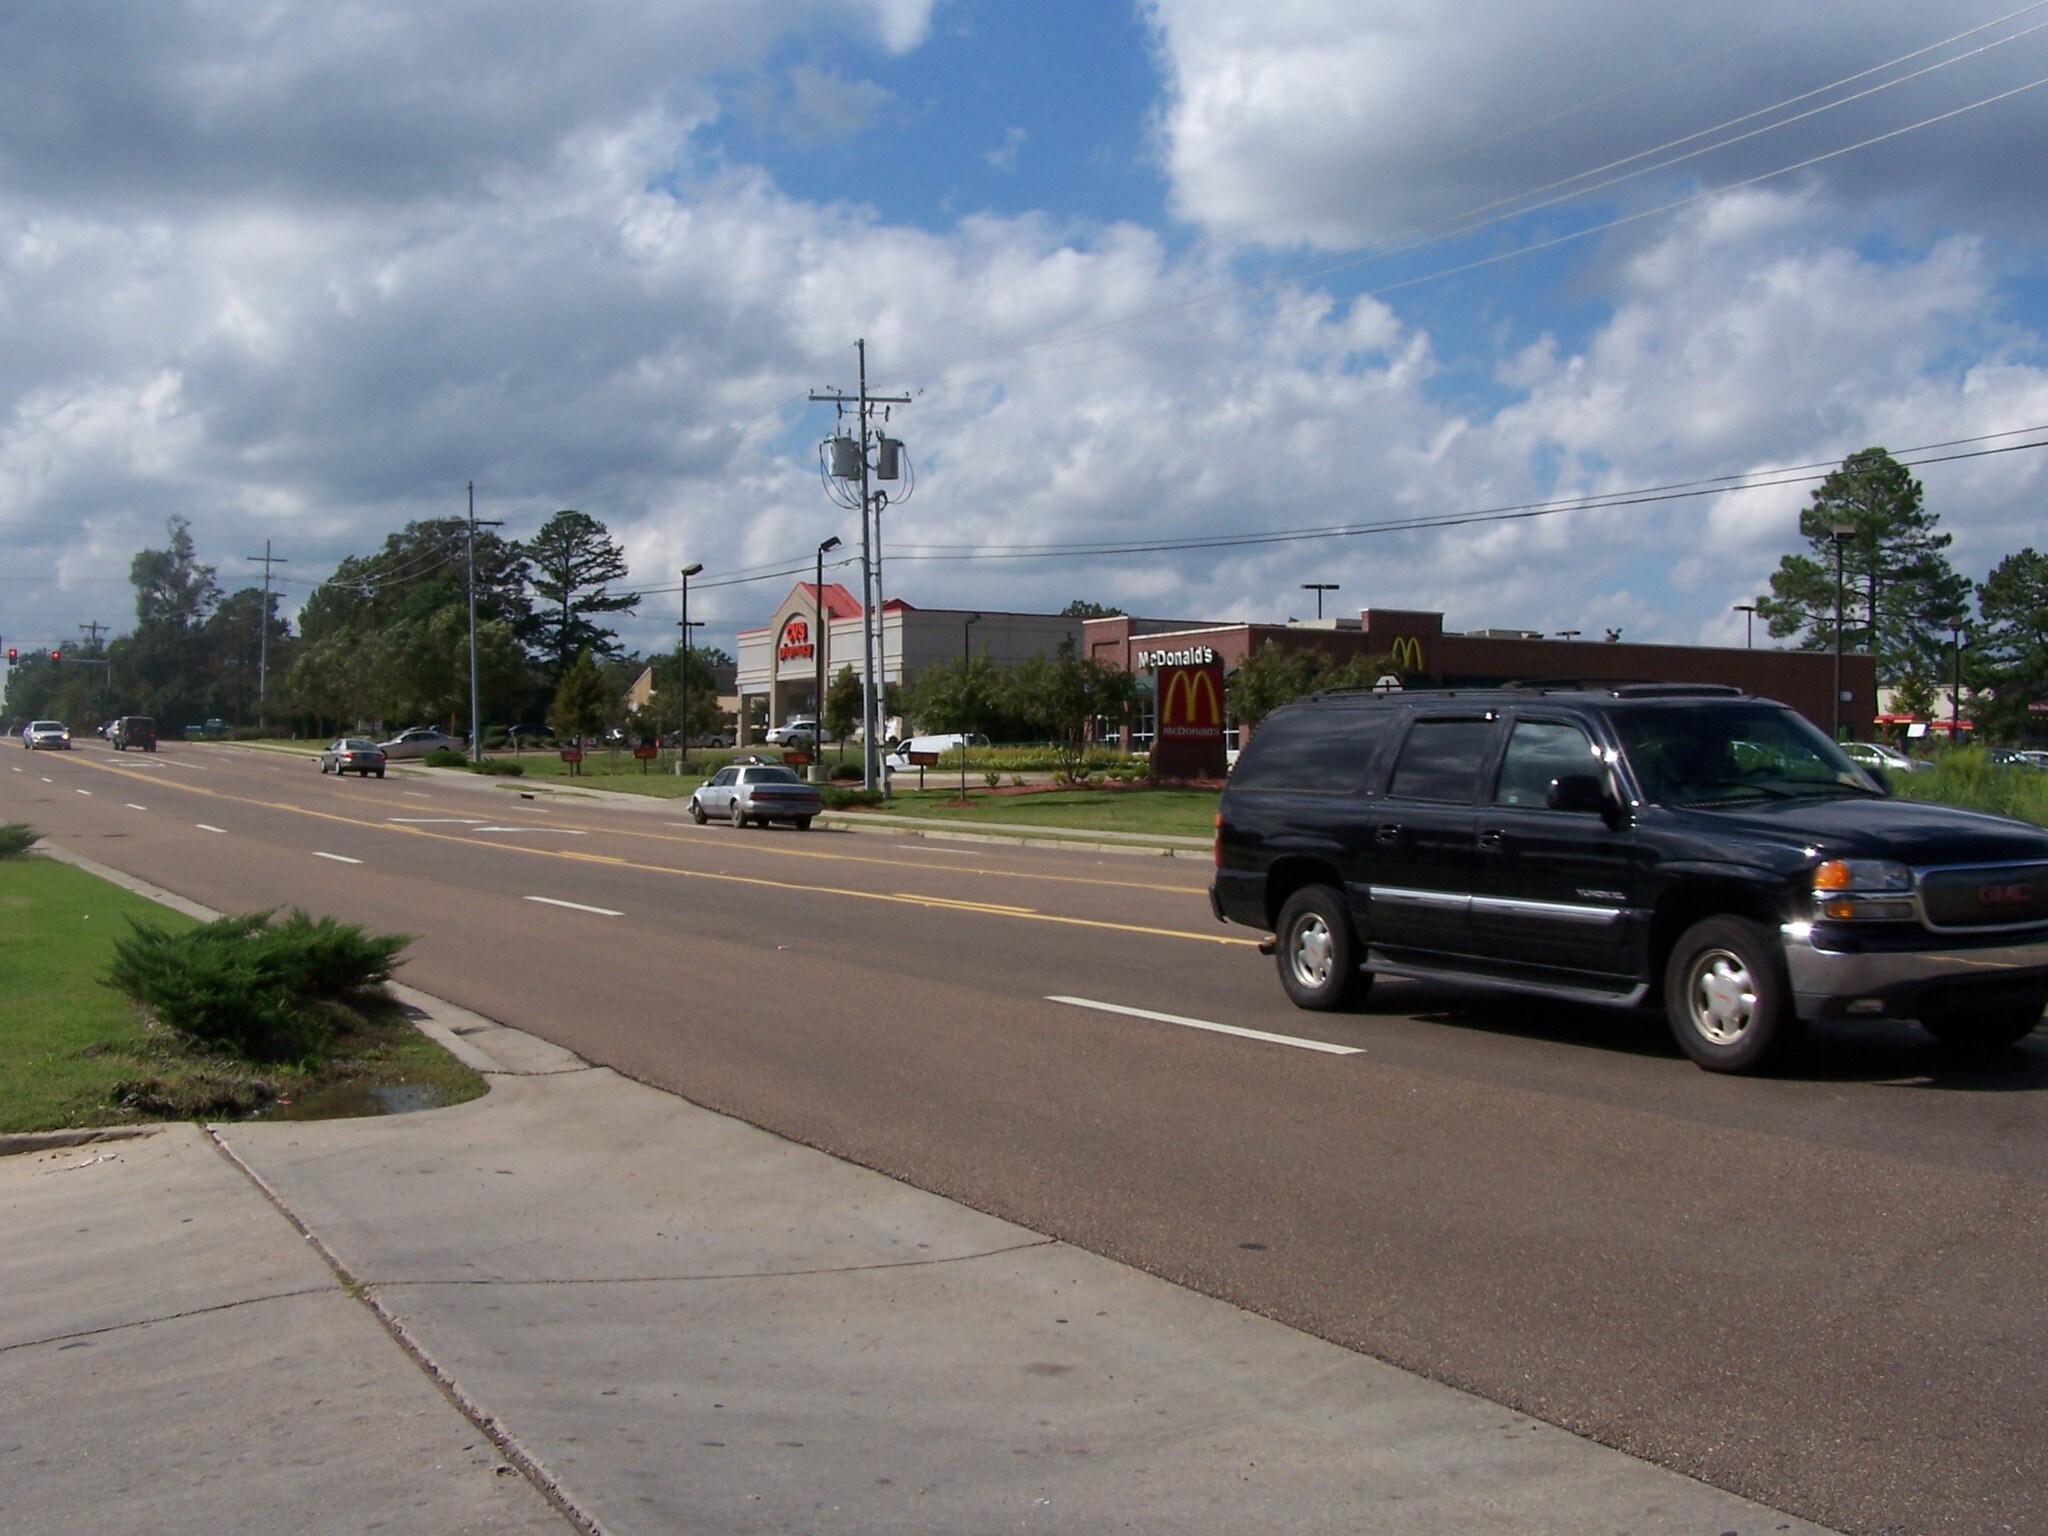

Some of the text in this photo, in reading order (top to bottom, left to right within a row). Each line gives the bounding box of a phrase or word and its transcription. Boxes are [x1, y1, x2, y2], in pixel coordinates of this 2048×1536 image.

[786, 622, 806, 641] CVS
[1138, 645, 1212, 668] McDonald's
[1163, 726, 1221, 736] McDonald's
